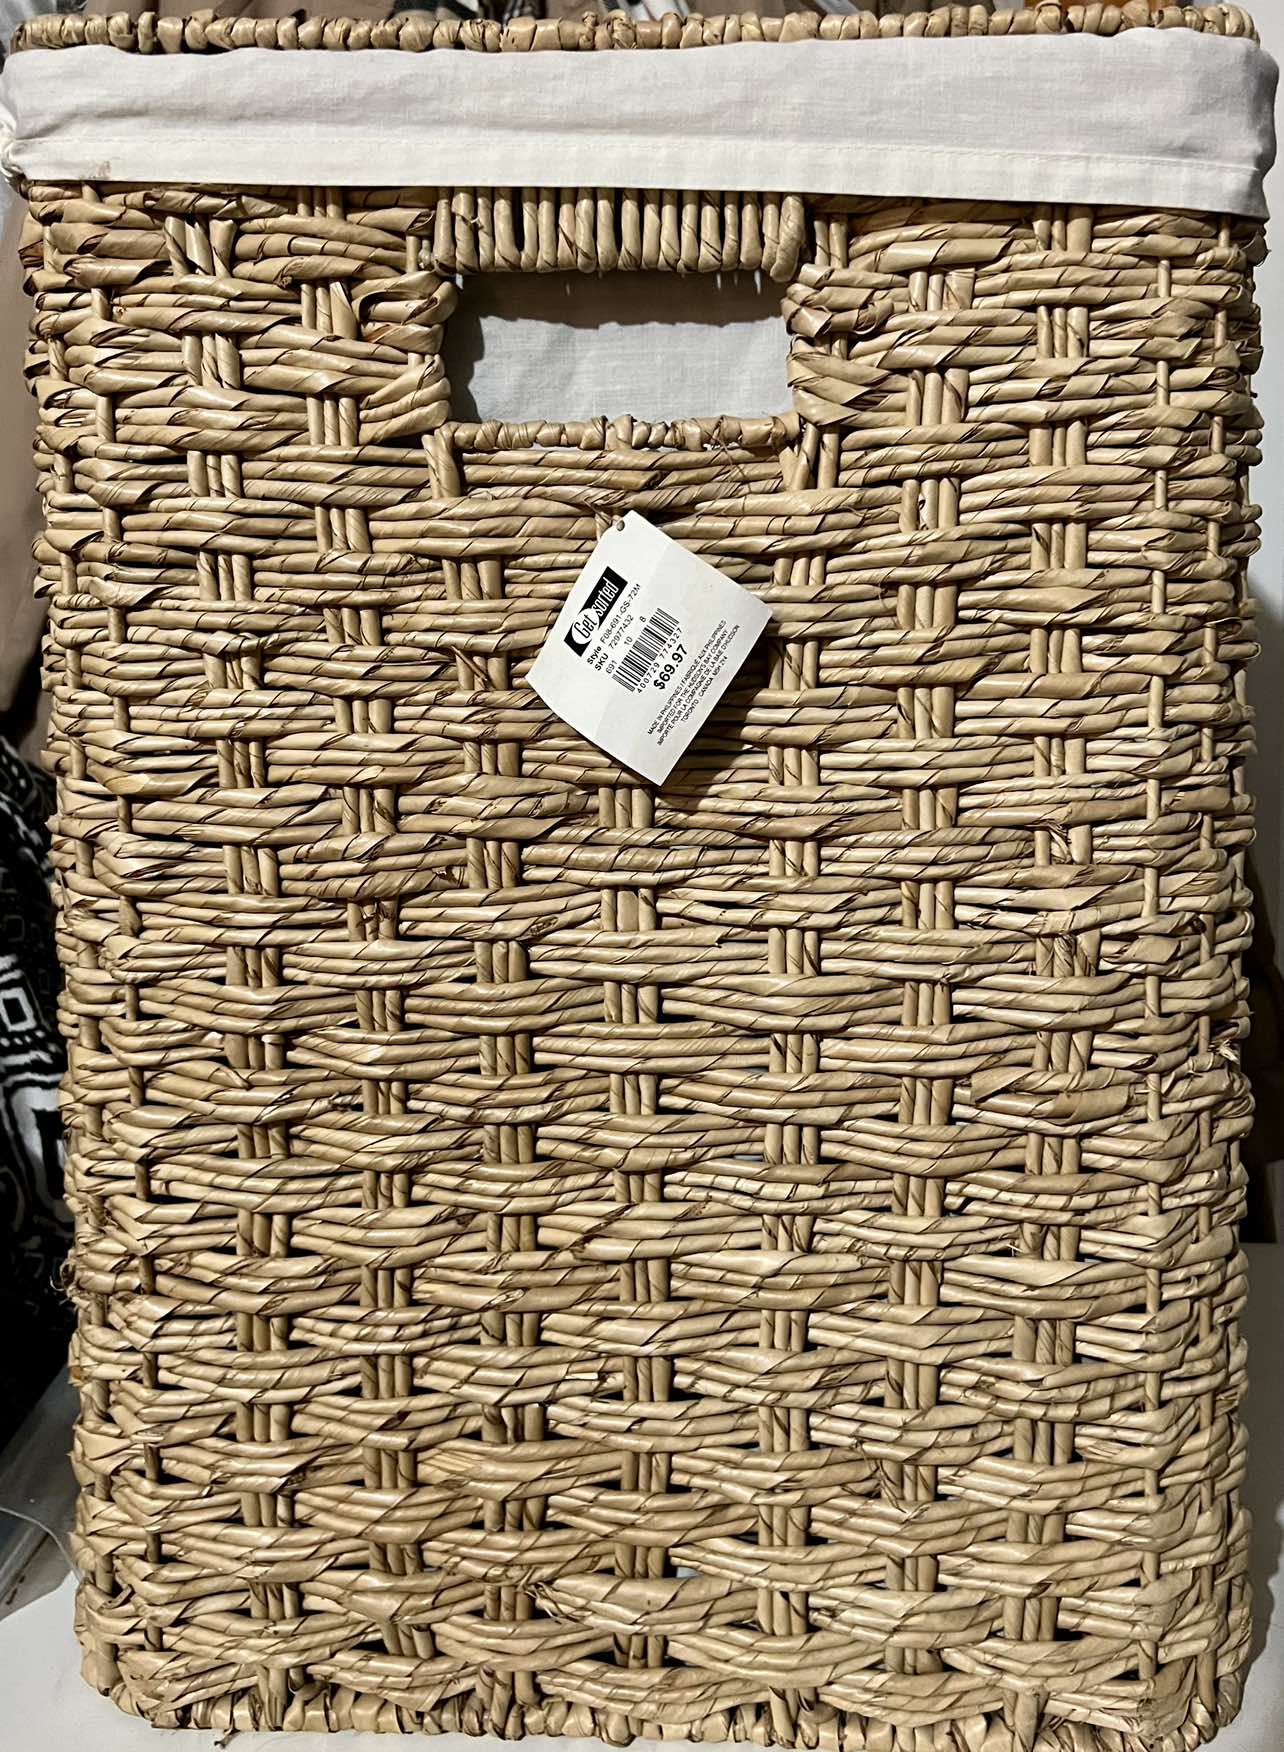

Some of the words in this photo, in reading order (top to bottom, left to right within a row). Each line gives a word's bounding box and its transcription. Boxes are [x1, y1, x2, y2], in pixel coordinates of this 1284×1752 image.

[573, 613, 599, 640] Get
[591, 576, 619, 616] sorted
[586, 645, 602, 665] Style
[594, 652, 609, 671] SKU
[608, 614, 634, 649] 72977432
[605, 659, 617, 674] 691
[623, 636, 633, 645] 10
[639, 615, 646, 623] 8
[653, 643, 687, 690] $69.97
[647, 719, 660, 735] MADE
[659, 685, 683, 715] PHILIPPINES
[697, 648, 707, 660] AUX
[656, 708, 676, 734] IMPORTED
[672, 697, 683, 709] FOR
[680, 687, 690, 698] THE
[703, 652, 712, 664] BAY
[710, 629, 728, 654] COMPANY
[670, 709, 683, 725] POUR
[680, 703, 688, 711] LA
[684, 674, 707, 704] COMPAGNIE
[703, 667, 712, 676] DE
